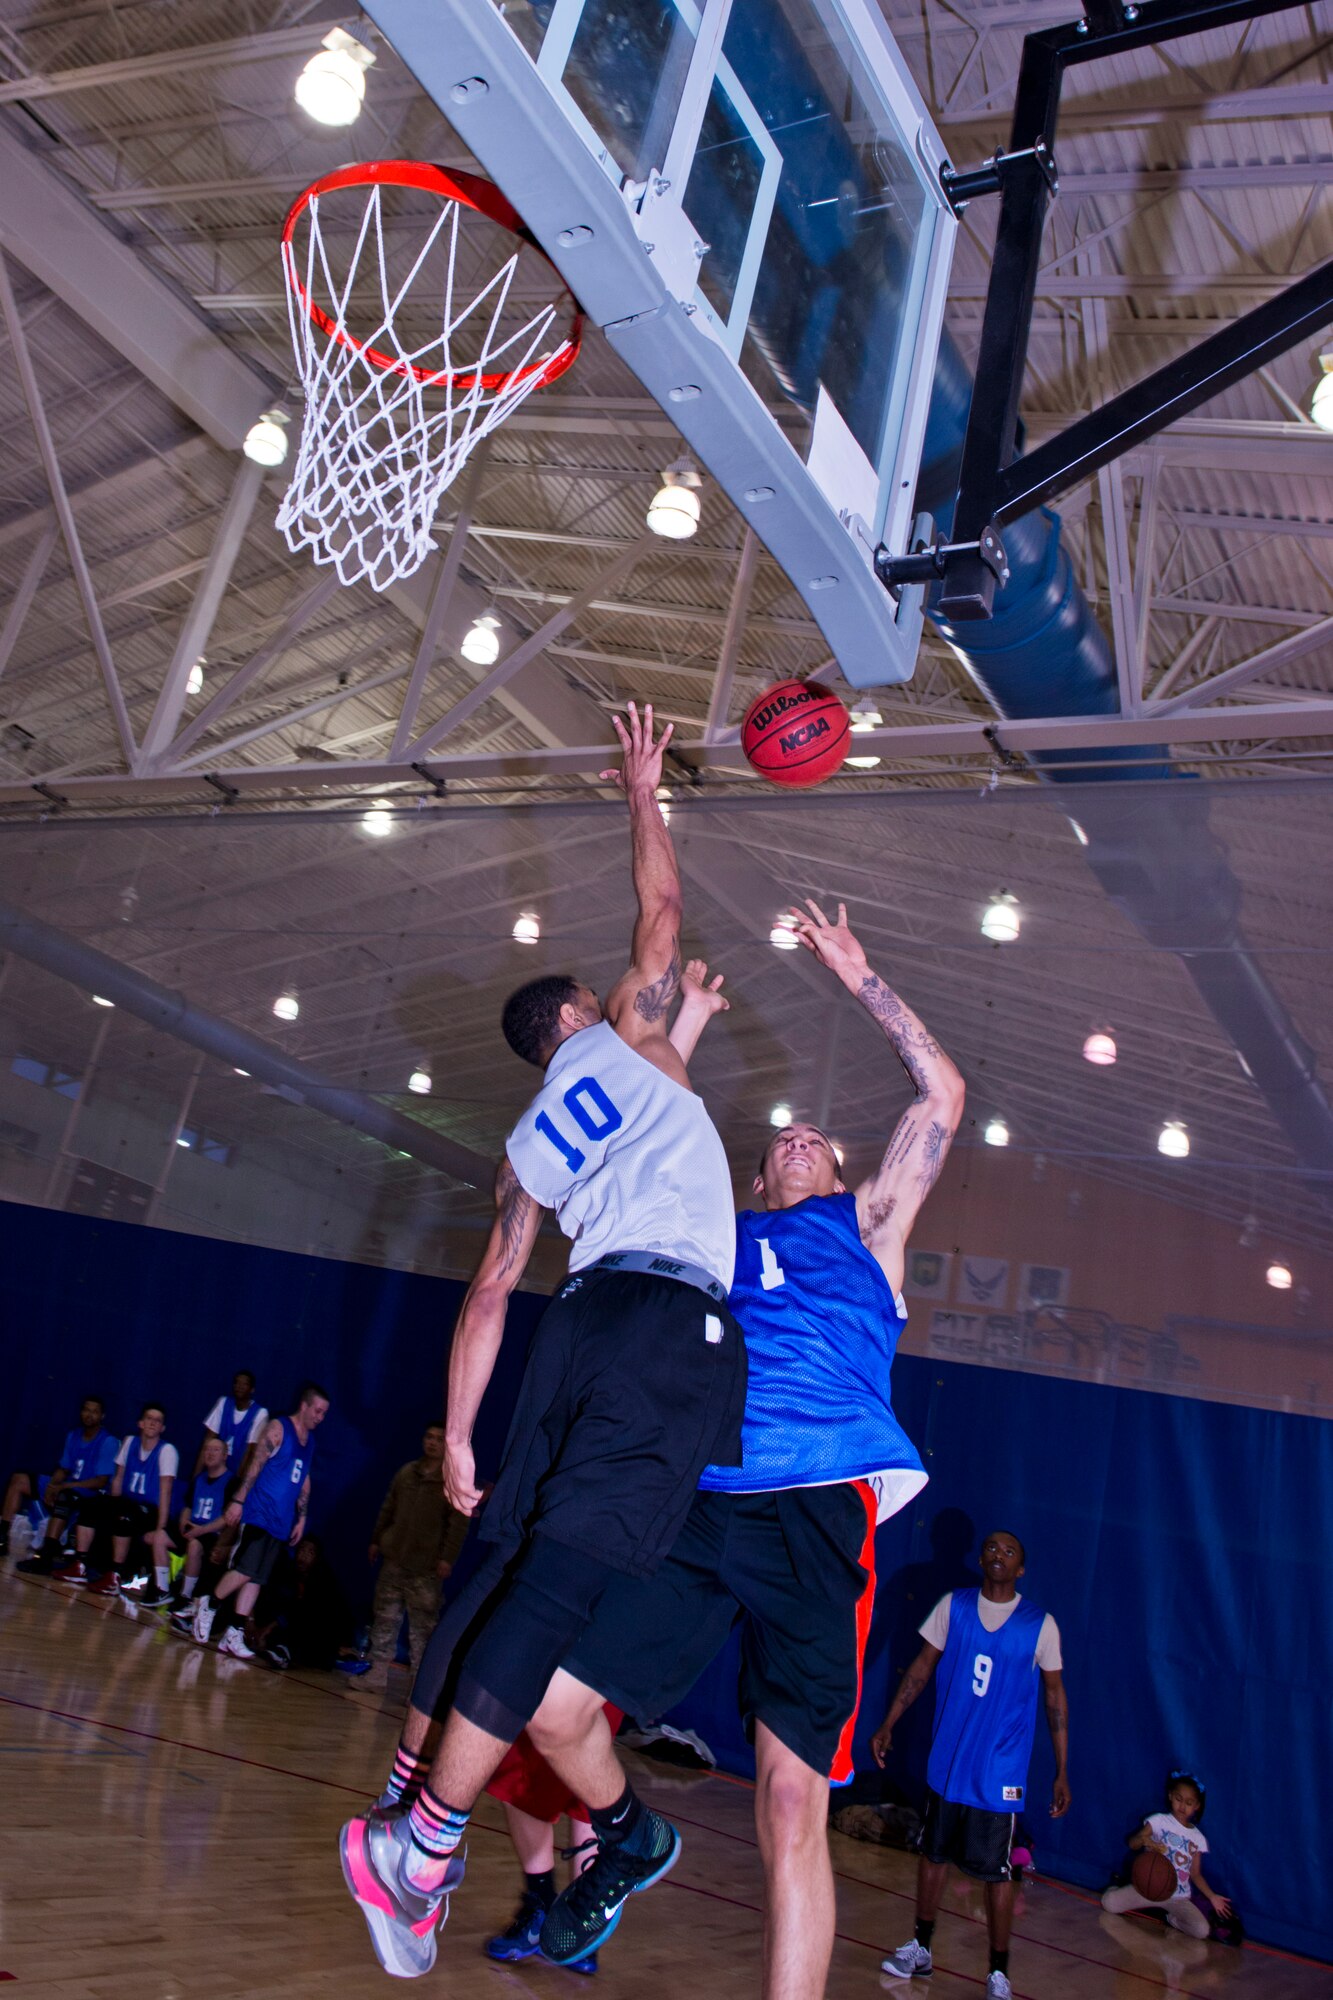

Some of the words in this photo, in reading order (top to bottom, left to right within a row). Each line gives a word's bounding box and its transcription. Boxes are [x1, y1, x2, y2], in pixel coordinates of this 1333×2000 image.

[752, 690, 825, 731] Wilson
[779, 717, 830, 754] NCAA
[535, 1077, 622, 1174] 10
[597, 1254, 627, 1267] NIKE
[647, 1258, 686, 1275] NIKE
[754, 1238, 785, 1290] 1
[291, 1459, 303, 1484] 6
[972, 1653, 993, 1697] 9
